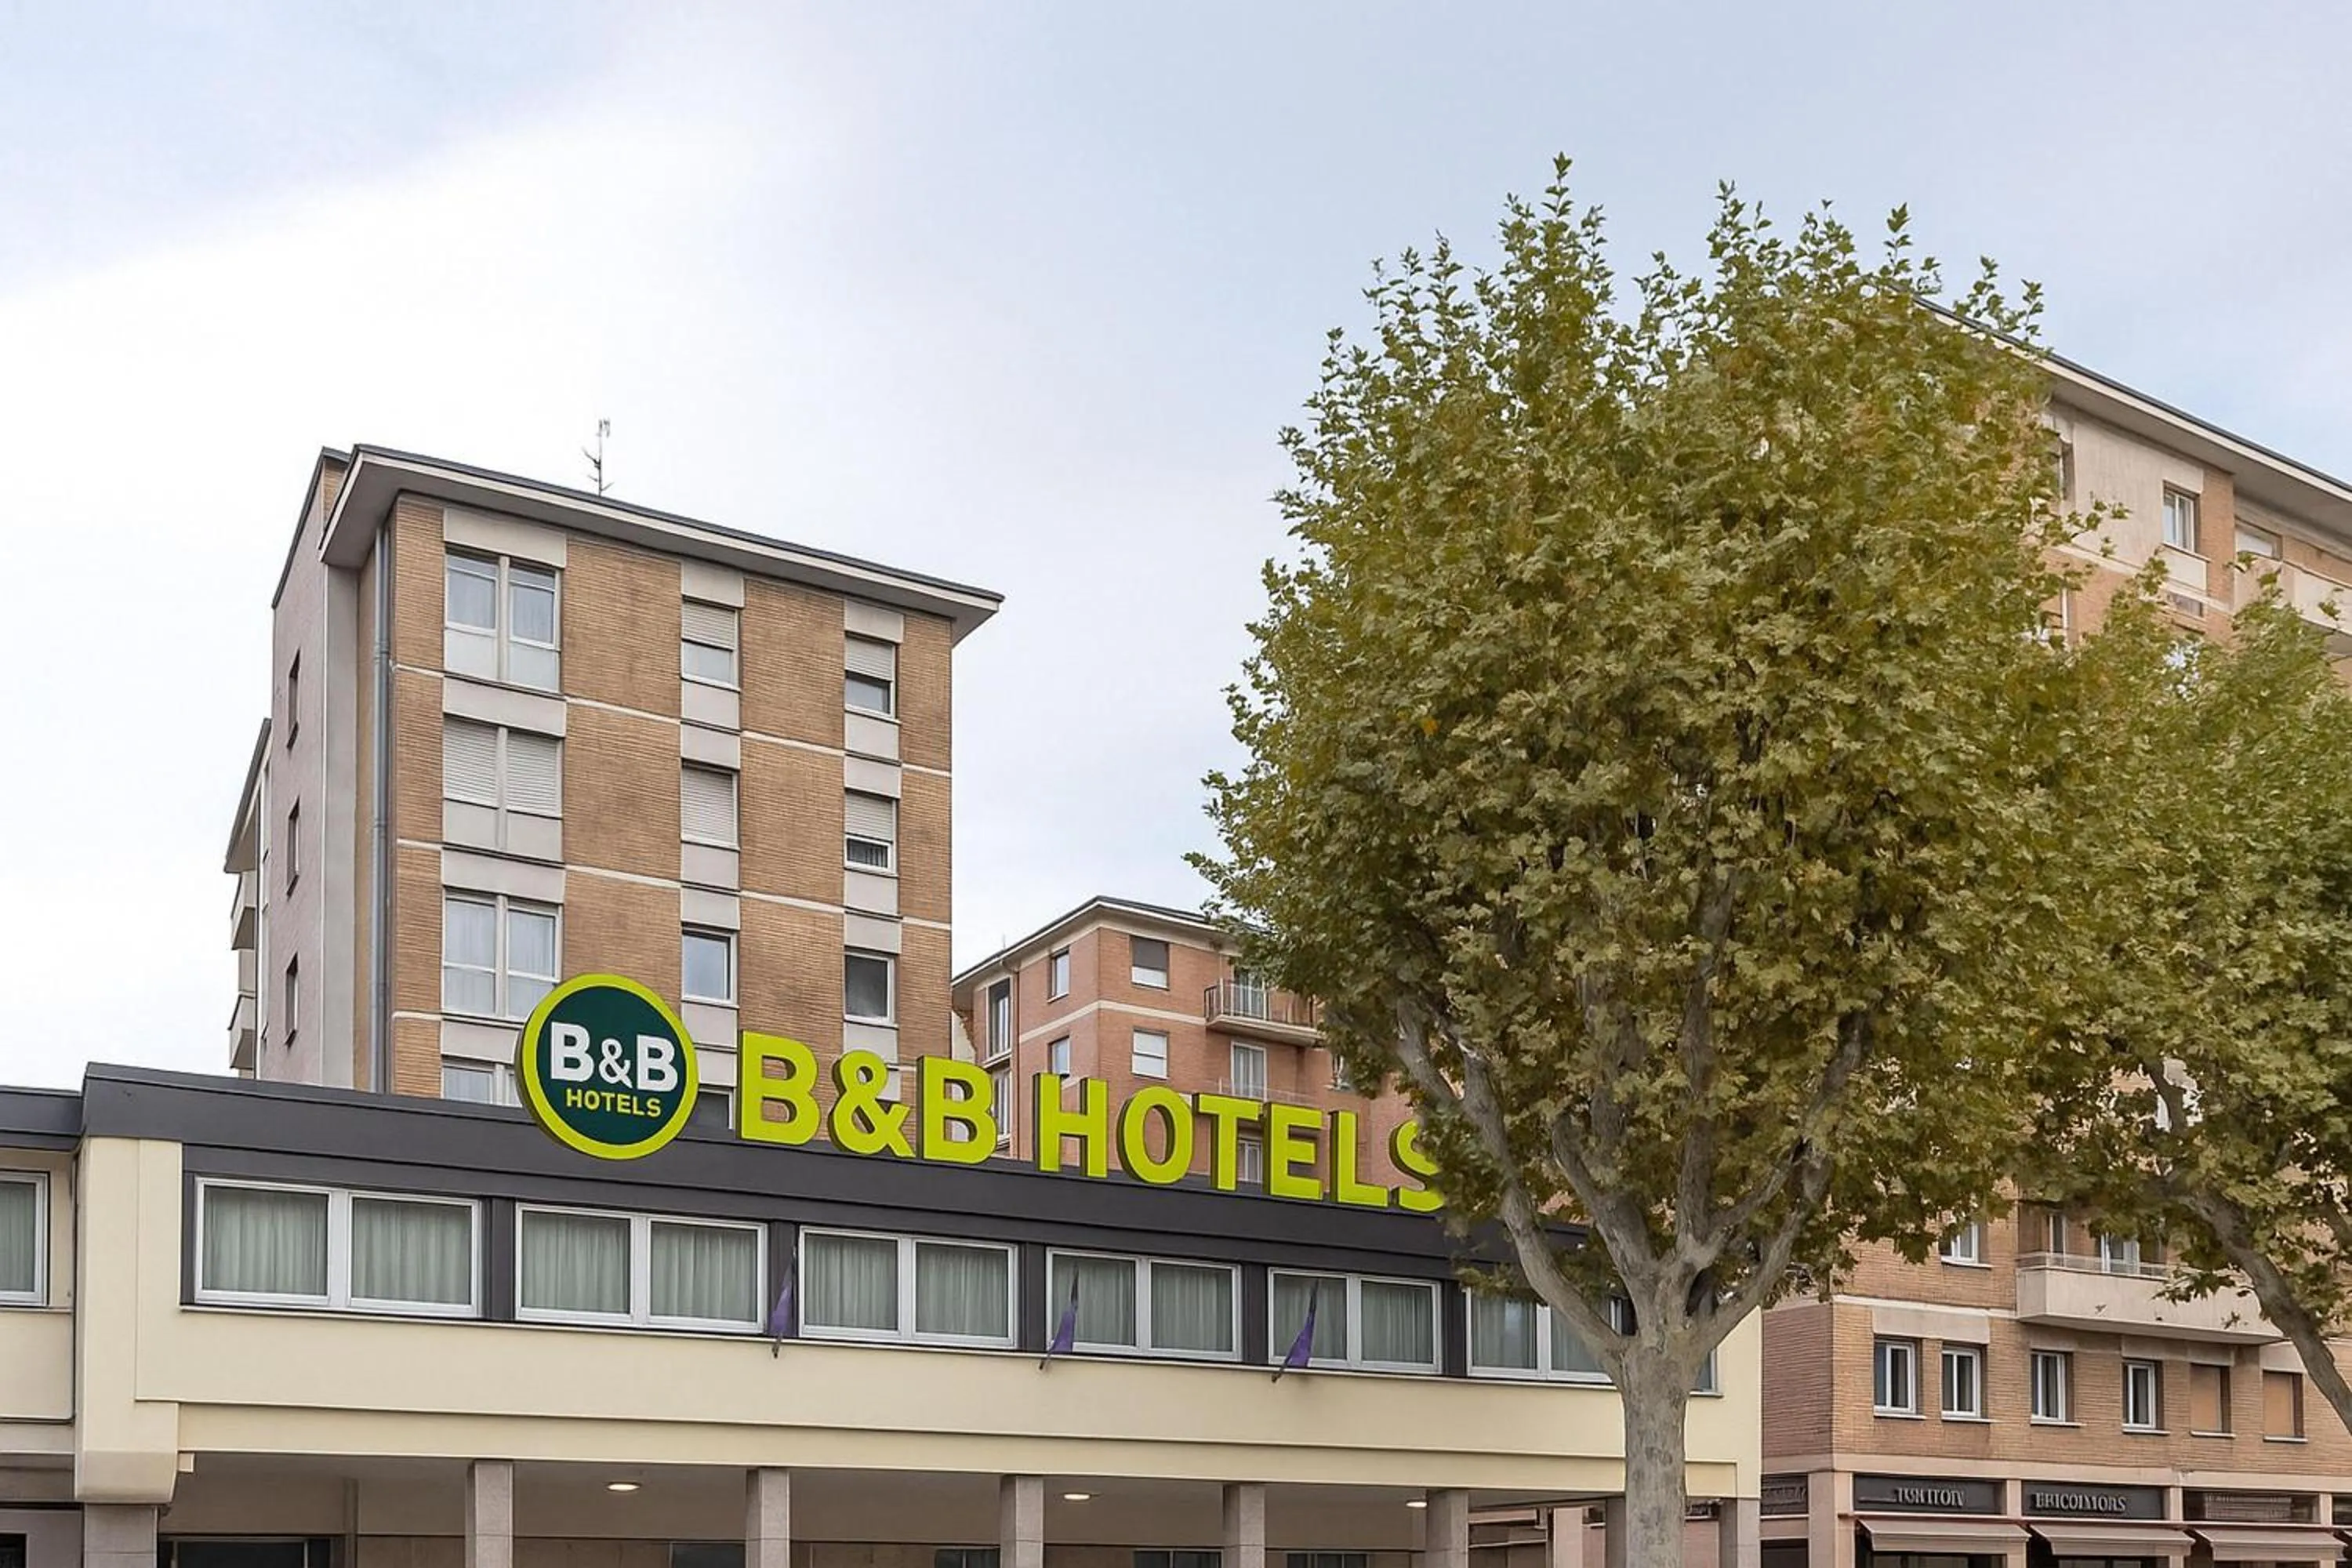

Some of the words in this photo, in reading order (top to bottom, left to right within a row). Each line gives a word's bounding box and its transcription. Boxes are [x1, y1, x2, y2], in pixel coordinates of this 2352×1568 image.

[551, 1022, 678, 1092] B&B
[566, 1088, 662, 1117] HOTELS
[739, 1029, 998, 1164] B&B
